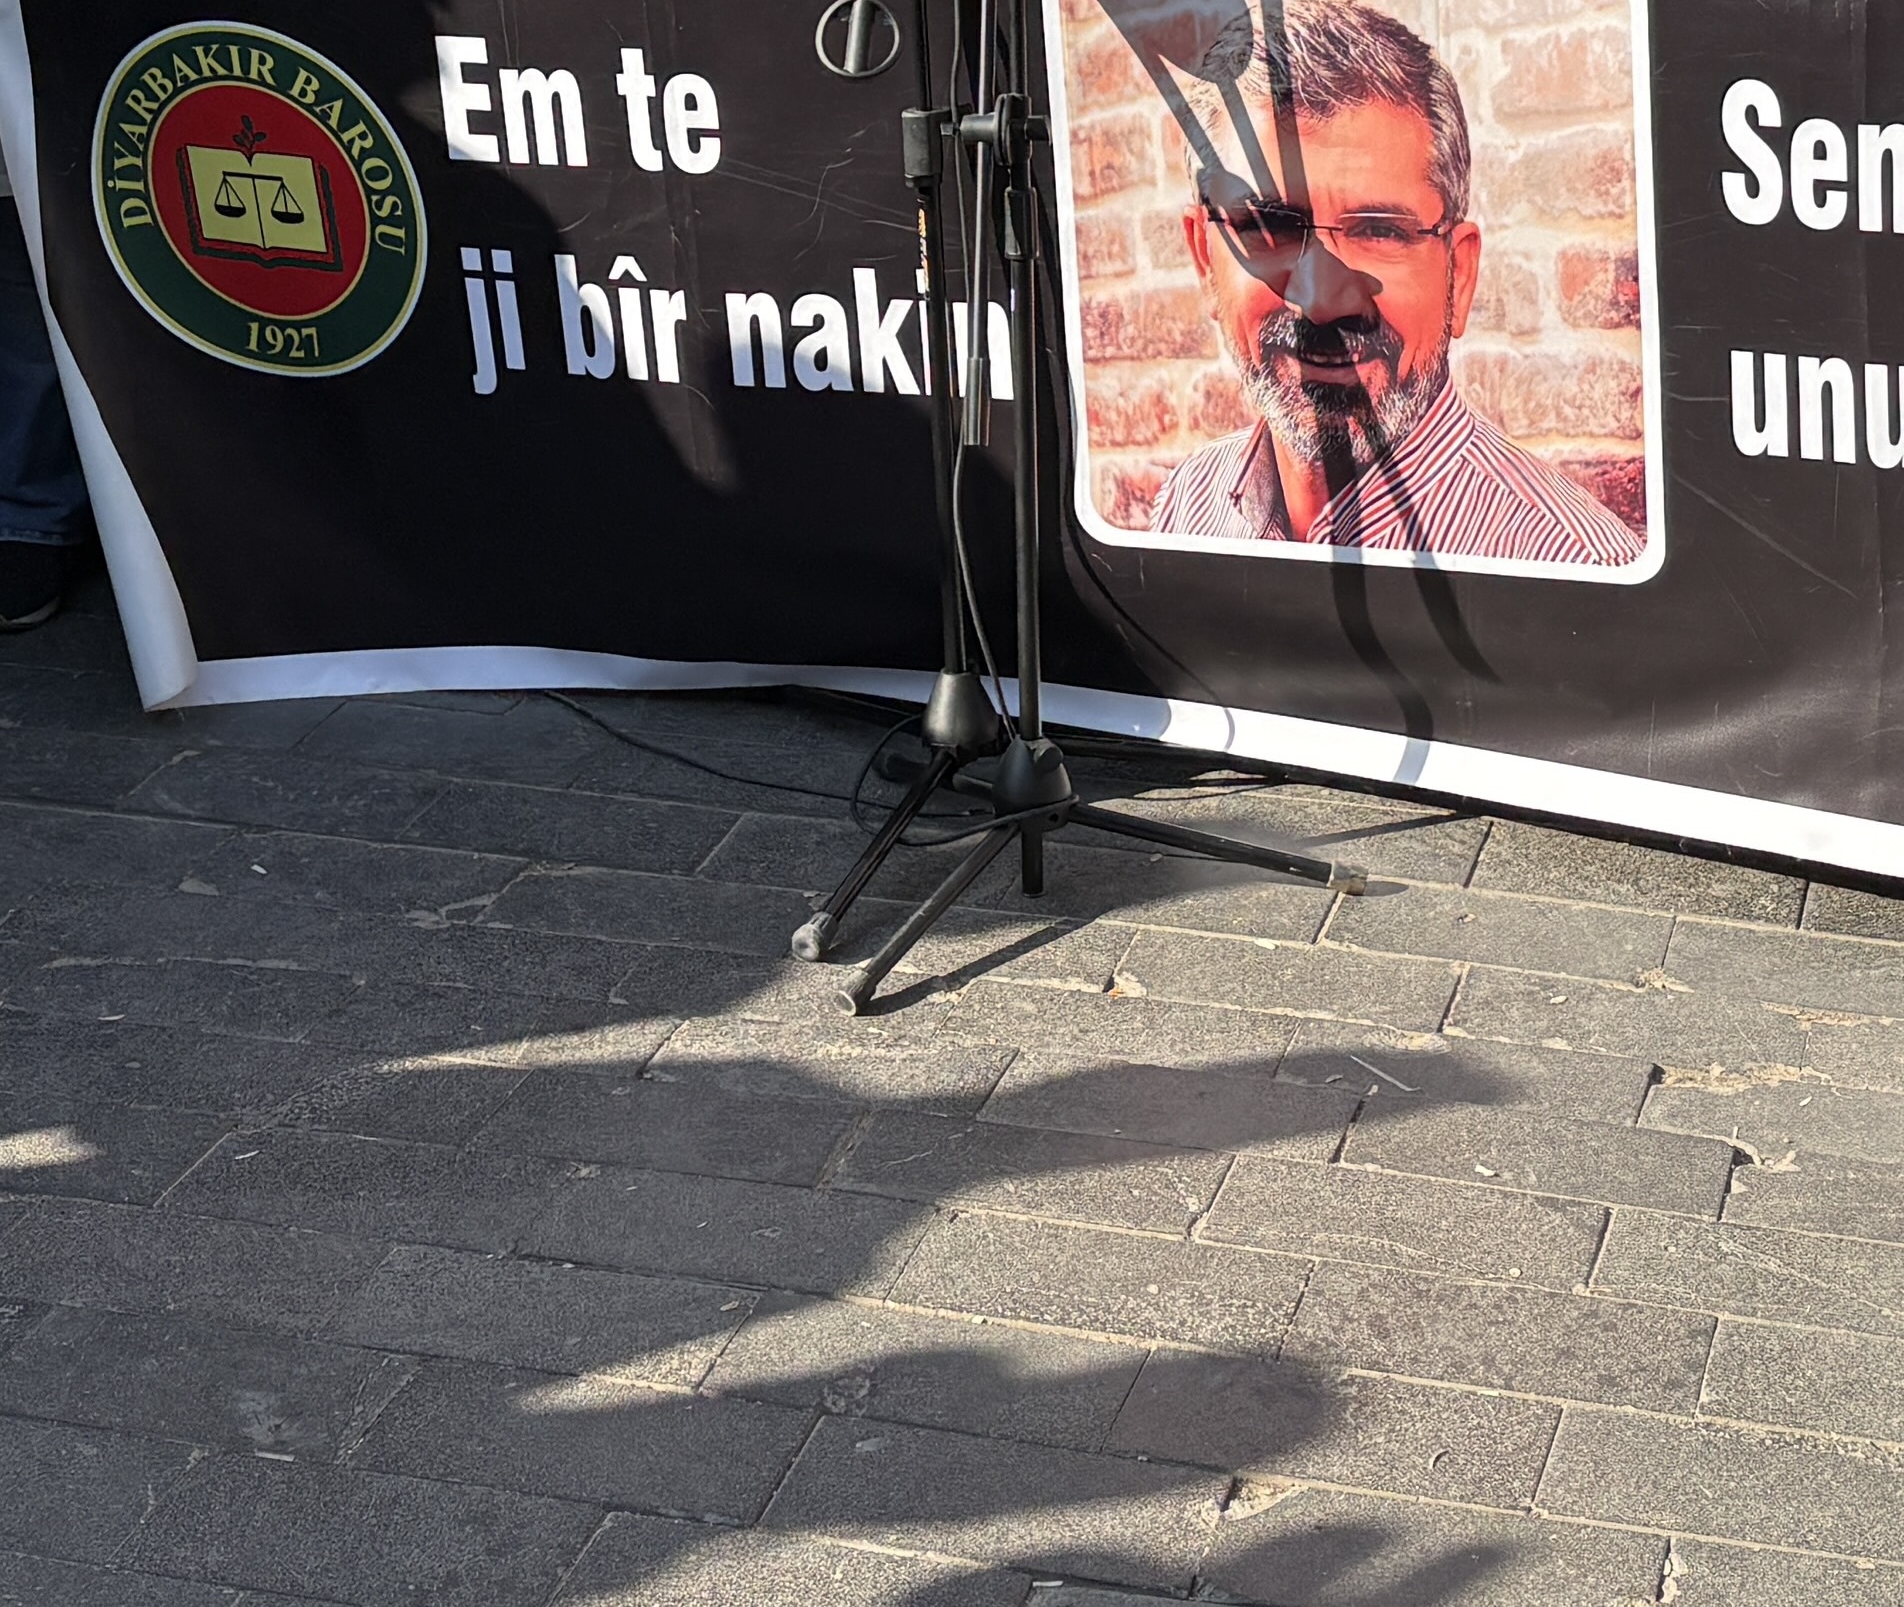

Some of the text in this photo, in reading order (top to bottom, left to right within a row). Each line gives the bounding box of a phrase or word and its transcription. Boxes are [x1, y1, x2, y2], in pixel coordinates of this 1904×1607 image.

[107, 44, 408, 256] DİYARBAKIR BAROSU
[434, 35, 722, 175] Em te
[245, 321, 320, 358] 1927
[459, 246, 527, 395] ji
[553, 253, 688, 385] bîr
